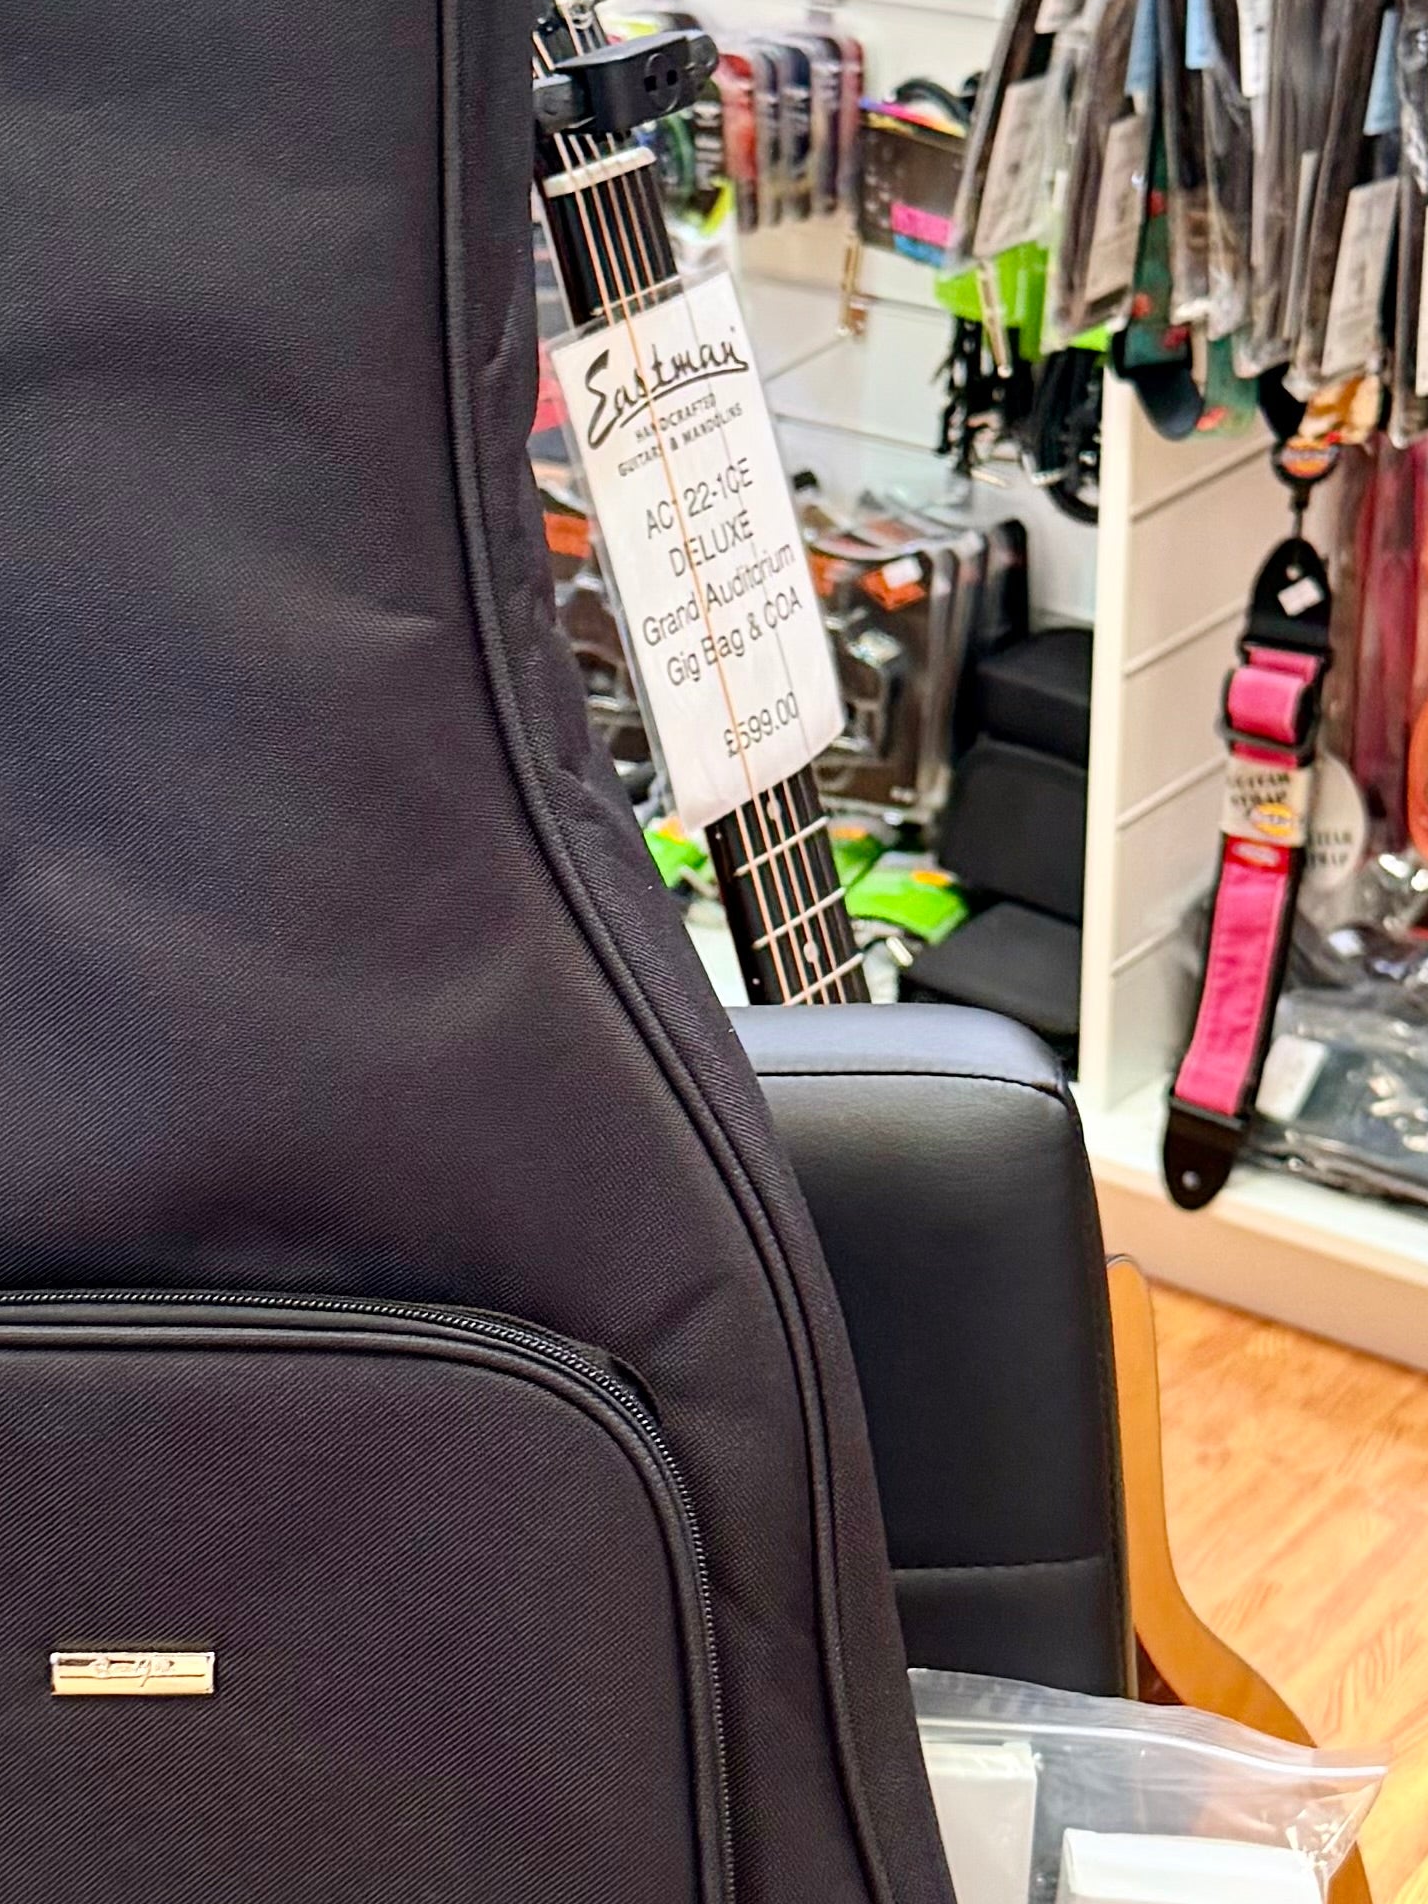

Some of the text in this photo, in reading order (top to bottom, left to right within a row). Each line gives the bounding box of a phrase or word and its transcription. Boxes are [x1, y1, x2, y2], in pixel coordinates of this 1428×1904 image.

[585, 342, 749, 449] Eastman
[646, 457, 753, 539] AC22-1CE
[669, 510, 754, 578] DELUXE
[643, 544, 796, 647] Grand Auditorium
[667, 586, 803, 687] Gig Bag & COA
[724, 692, 799, 758] £599.00
